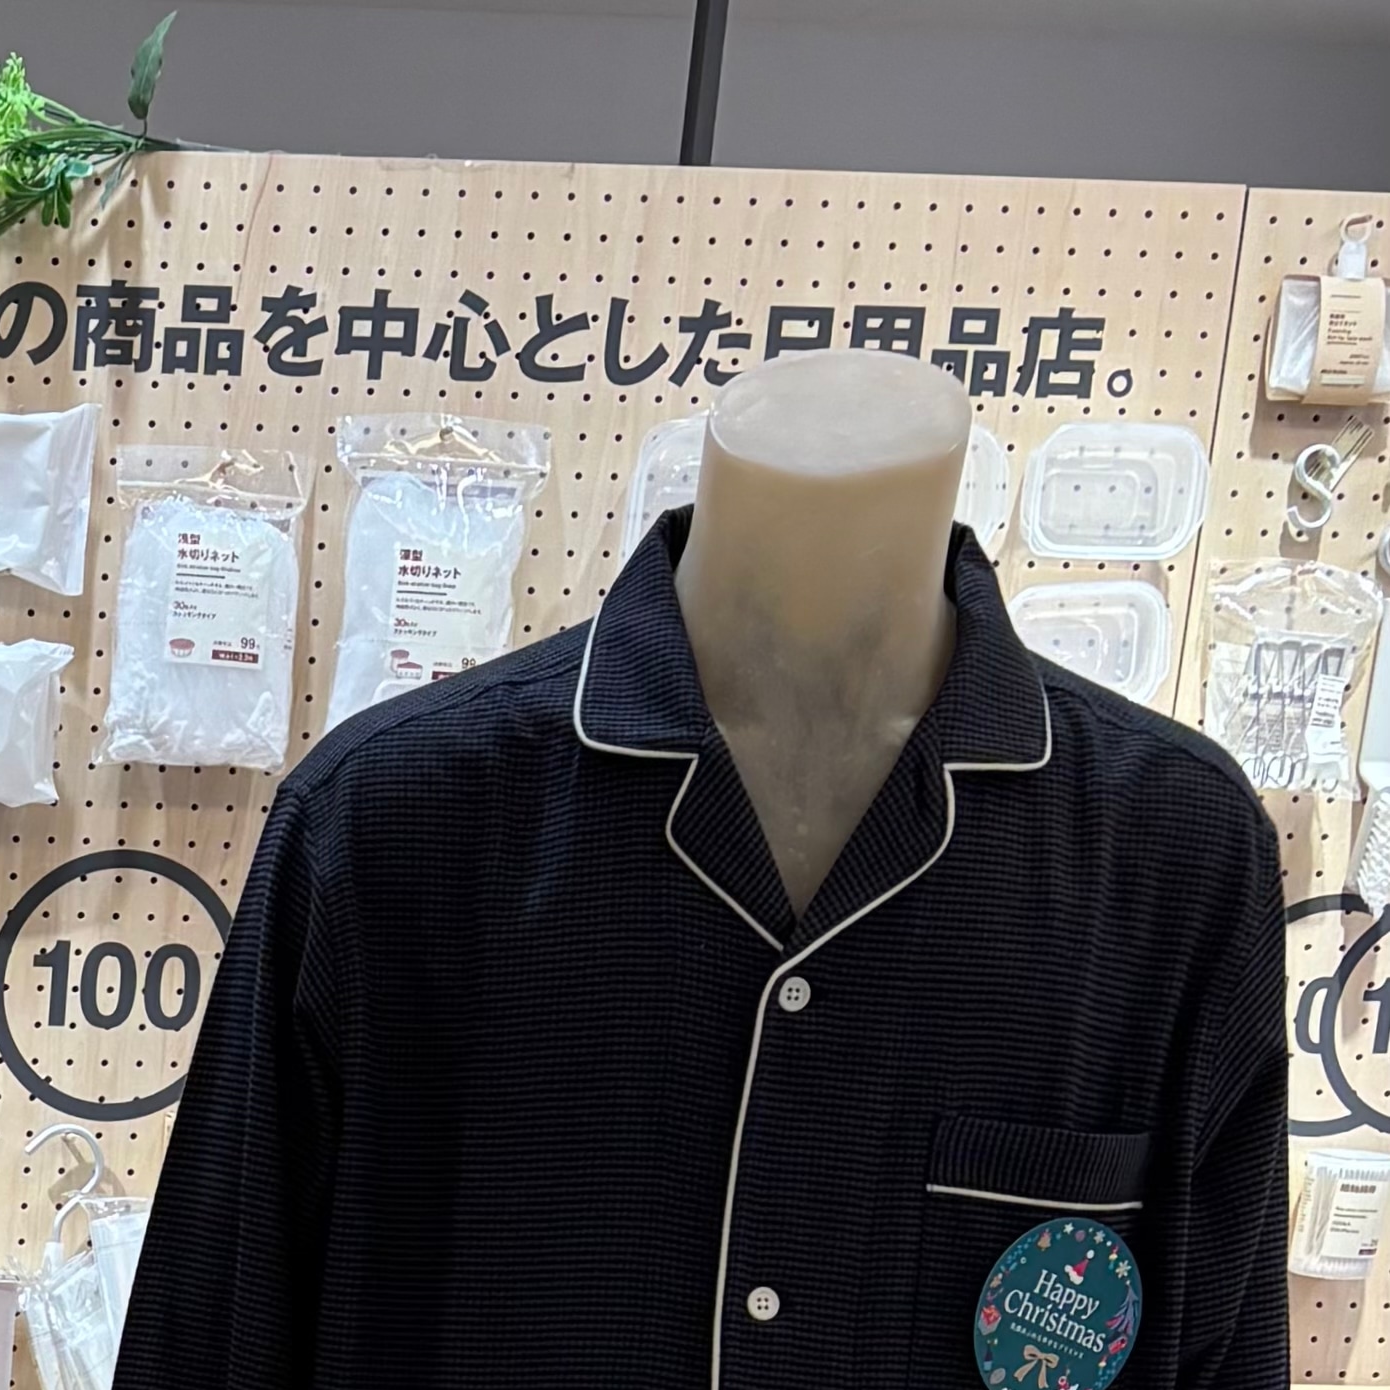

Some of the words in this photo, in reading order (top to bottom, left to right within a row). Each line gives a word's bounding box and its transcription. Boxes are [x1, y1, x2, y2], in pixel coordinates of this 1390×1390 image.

[177, 548, 240, 563] 水切りネット
[397, 564, 462, 579] 水切りネット
[32, 939, 202, 1030] 100
[1033, 1268, 1100, 1320] Happy
[1004, 1289, 1106, 1353] Christmas
